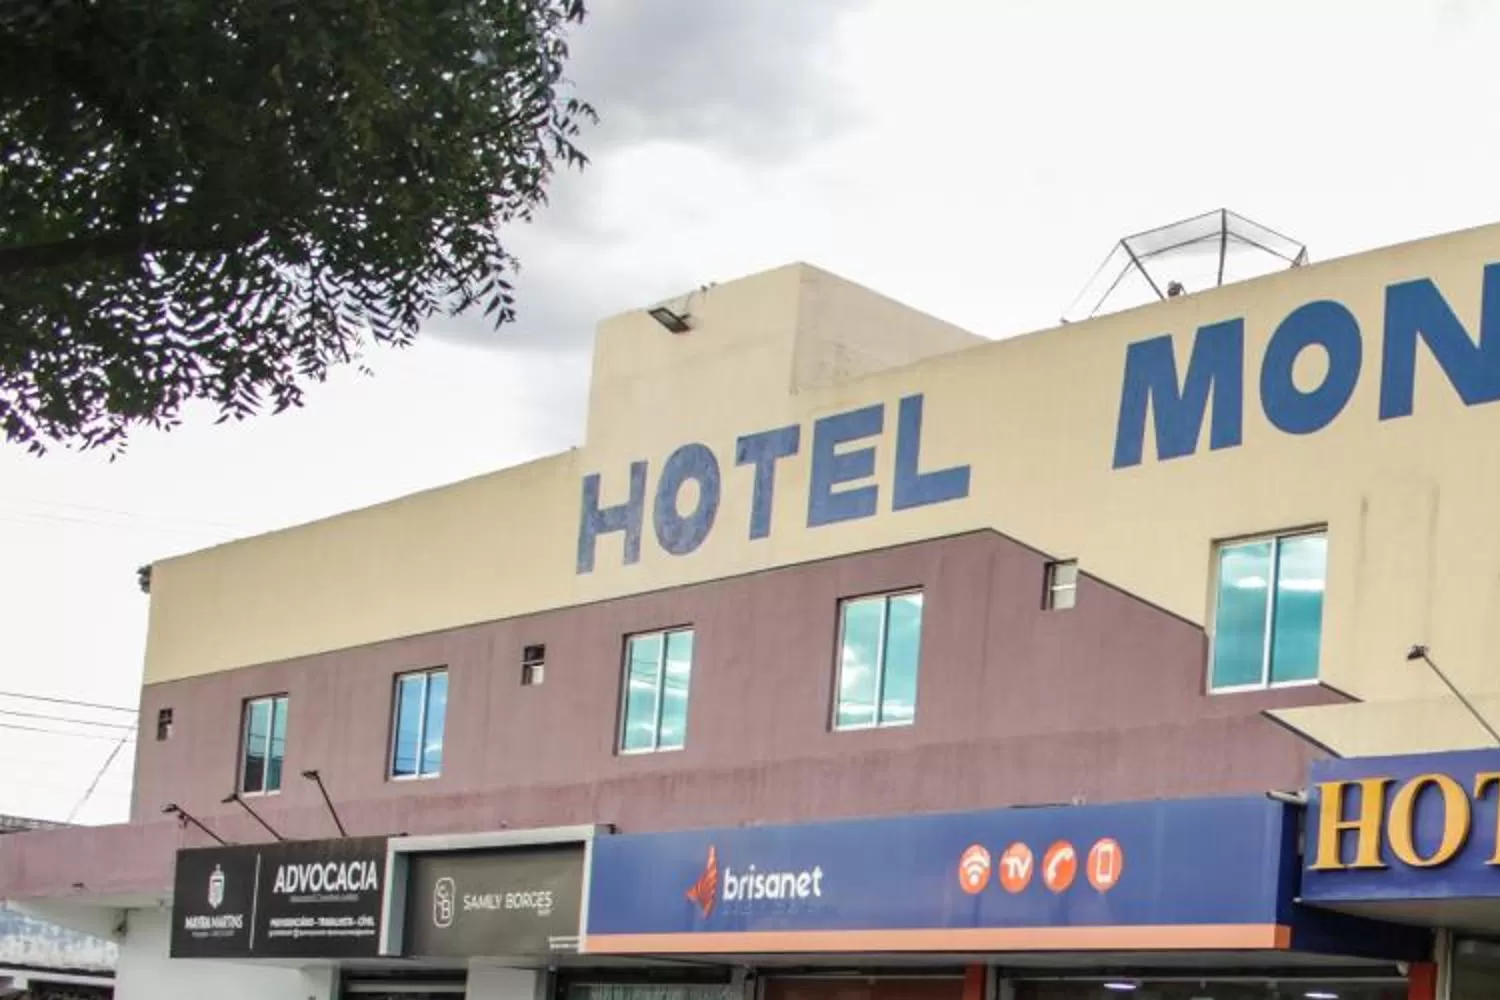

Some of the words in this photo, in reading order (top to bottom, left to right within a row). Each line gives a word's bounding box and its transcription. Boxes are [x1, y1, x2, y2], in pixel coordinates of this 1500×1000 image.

[576, 393, 971, 575] HOTEL
[272, 861, 378, 893] ADVOCACIA
[723, 864, 824, 901] brisanet
[1004, 856, 1031, 880] TV
